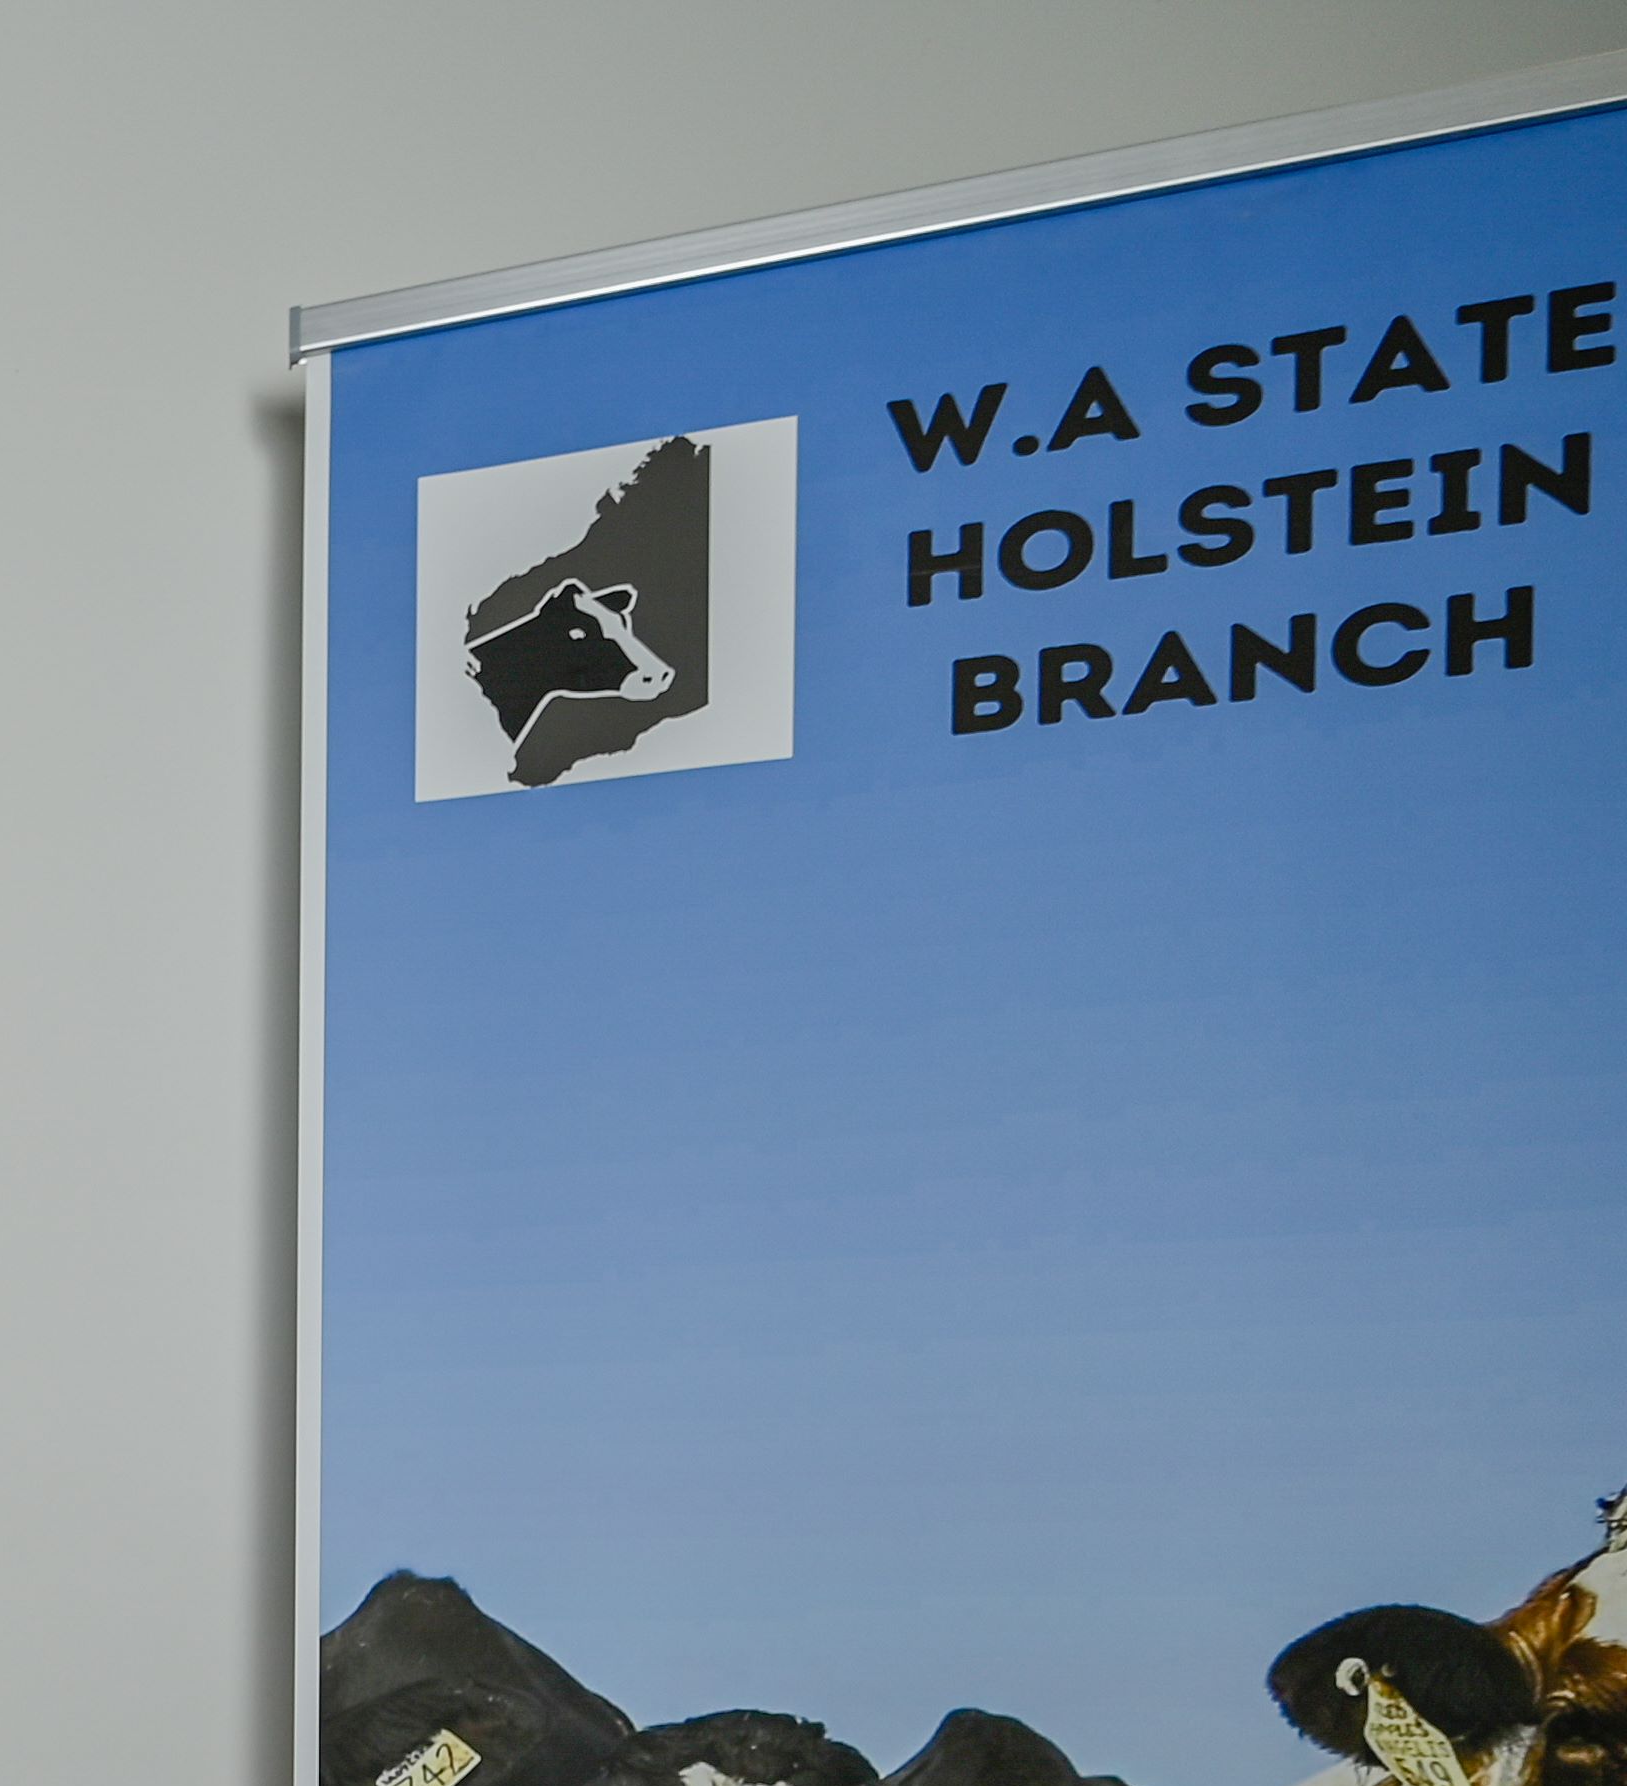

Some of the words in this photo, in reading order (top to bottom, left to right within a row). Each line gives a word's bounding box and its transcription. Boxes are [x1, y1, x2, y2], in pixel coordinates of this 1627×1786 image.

[1185, 281, 1616, 427] STATE
[907, 431, 1591, 608] HOLSTEIN
[951, 585, 1534, 736] BRANCH
